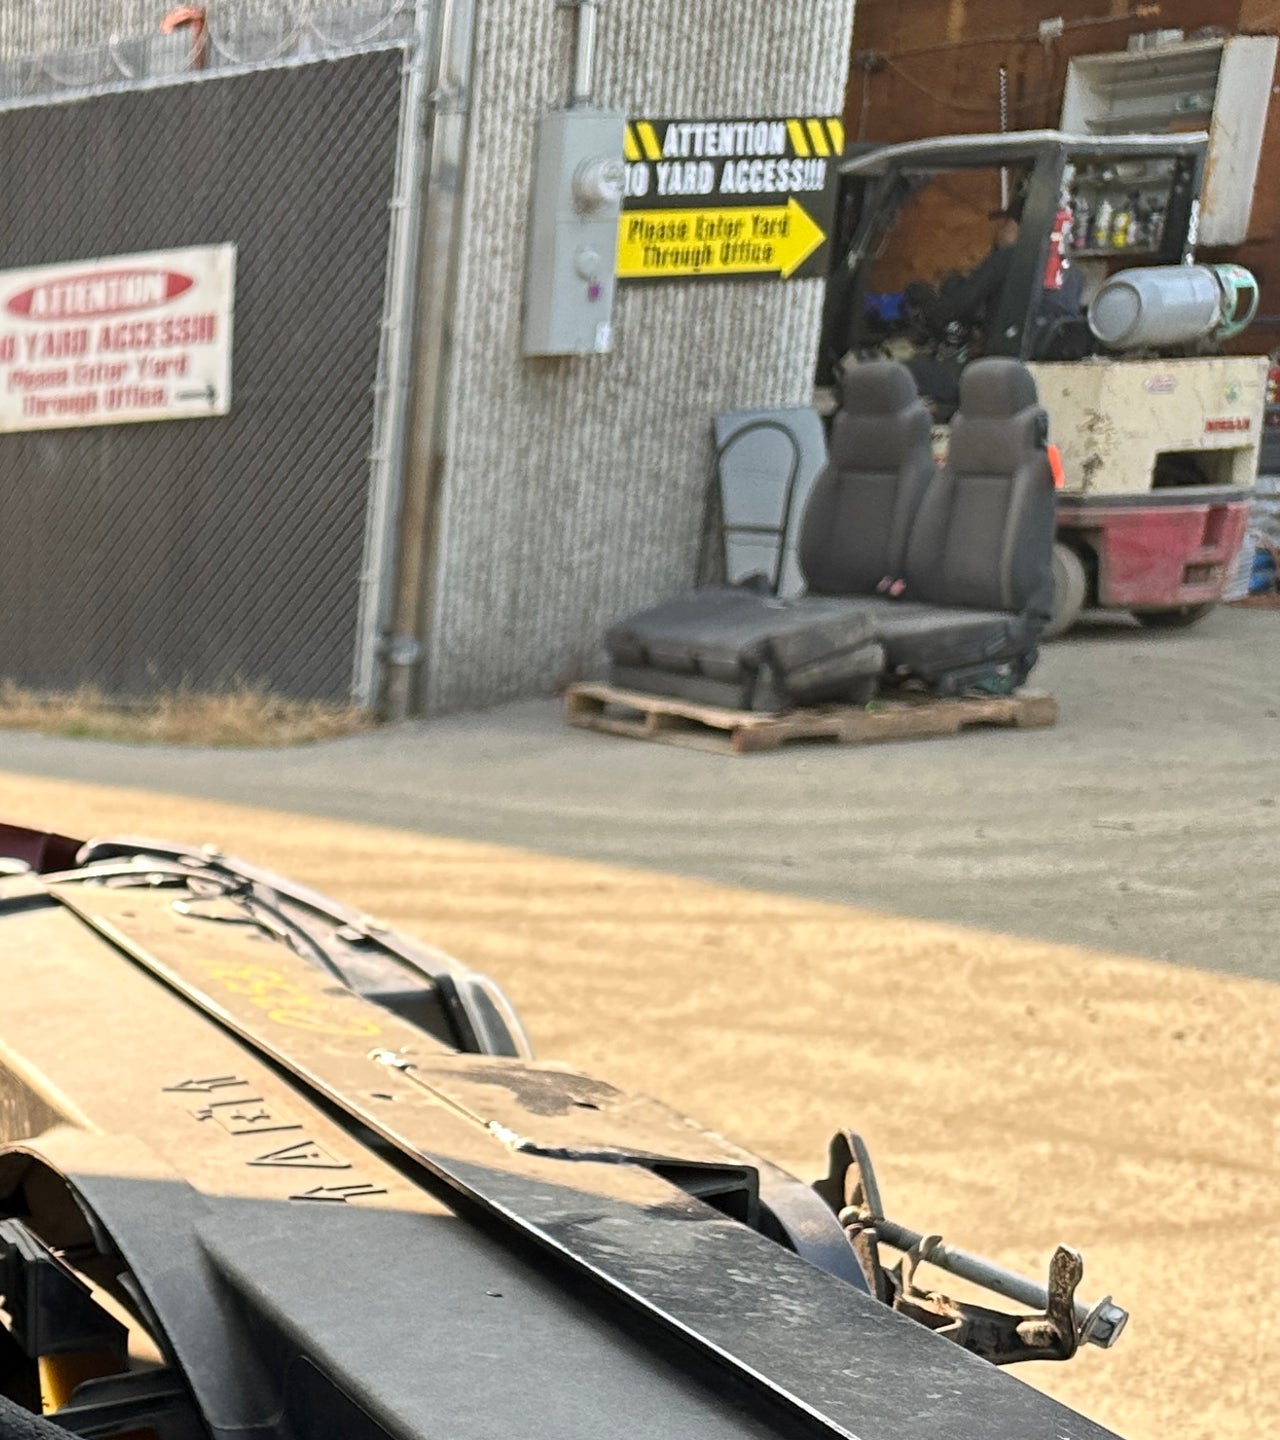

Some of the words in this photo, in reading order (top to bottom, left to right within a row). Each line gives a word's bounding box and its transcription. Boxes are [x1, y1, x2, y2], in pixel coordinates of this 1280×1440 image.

[663, 121, 786, 157] ATTENTION
[656, 160, 715, 196] YARD
[719, 159, 827, 195] ACCESS!!!
[628, 217, 687, 243] Please
[694, 215, 745, 240] Enter
[751, 213, 791, 238] Yard
[642, 243, 712, 268] Through
[719, 240, 773, 264] Office
[24, 327, 89, 361] YARD
